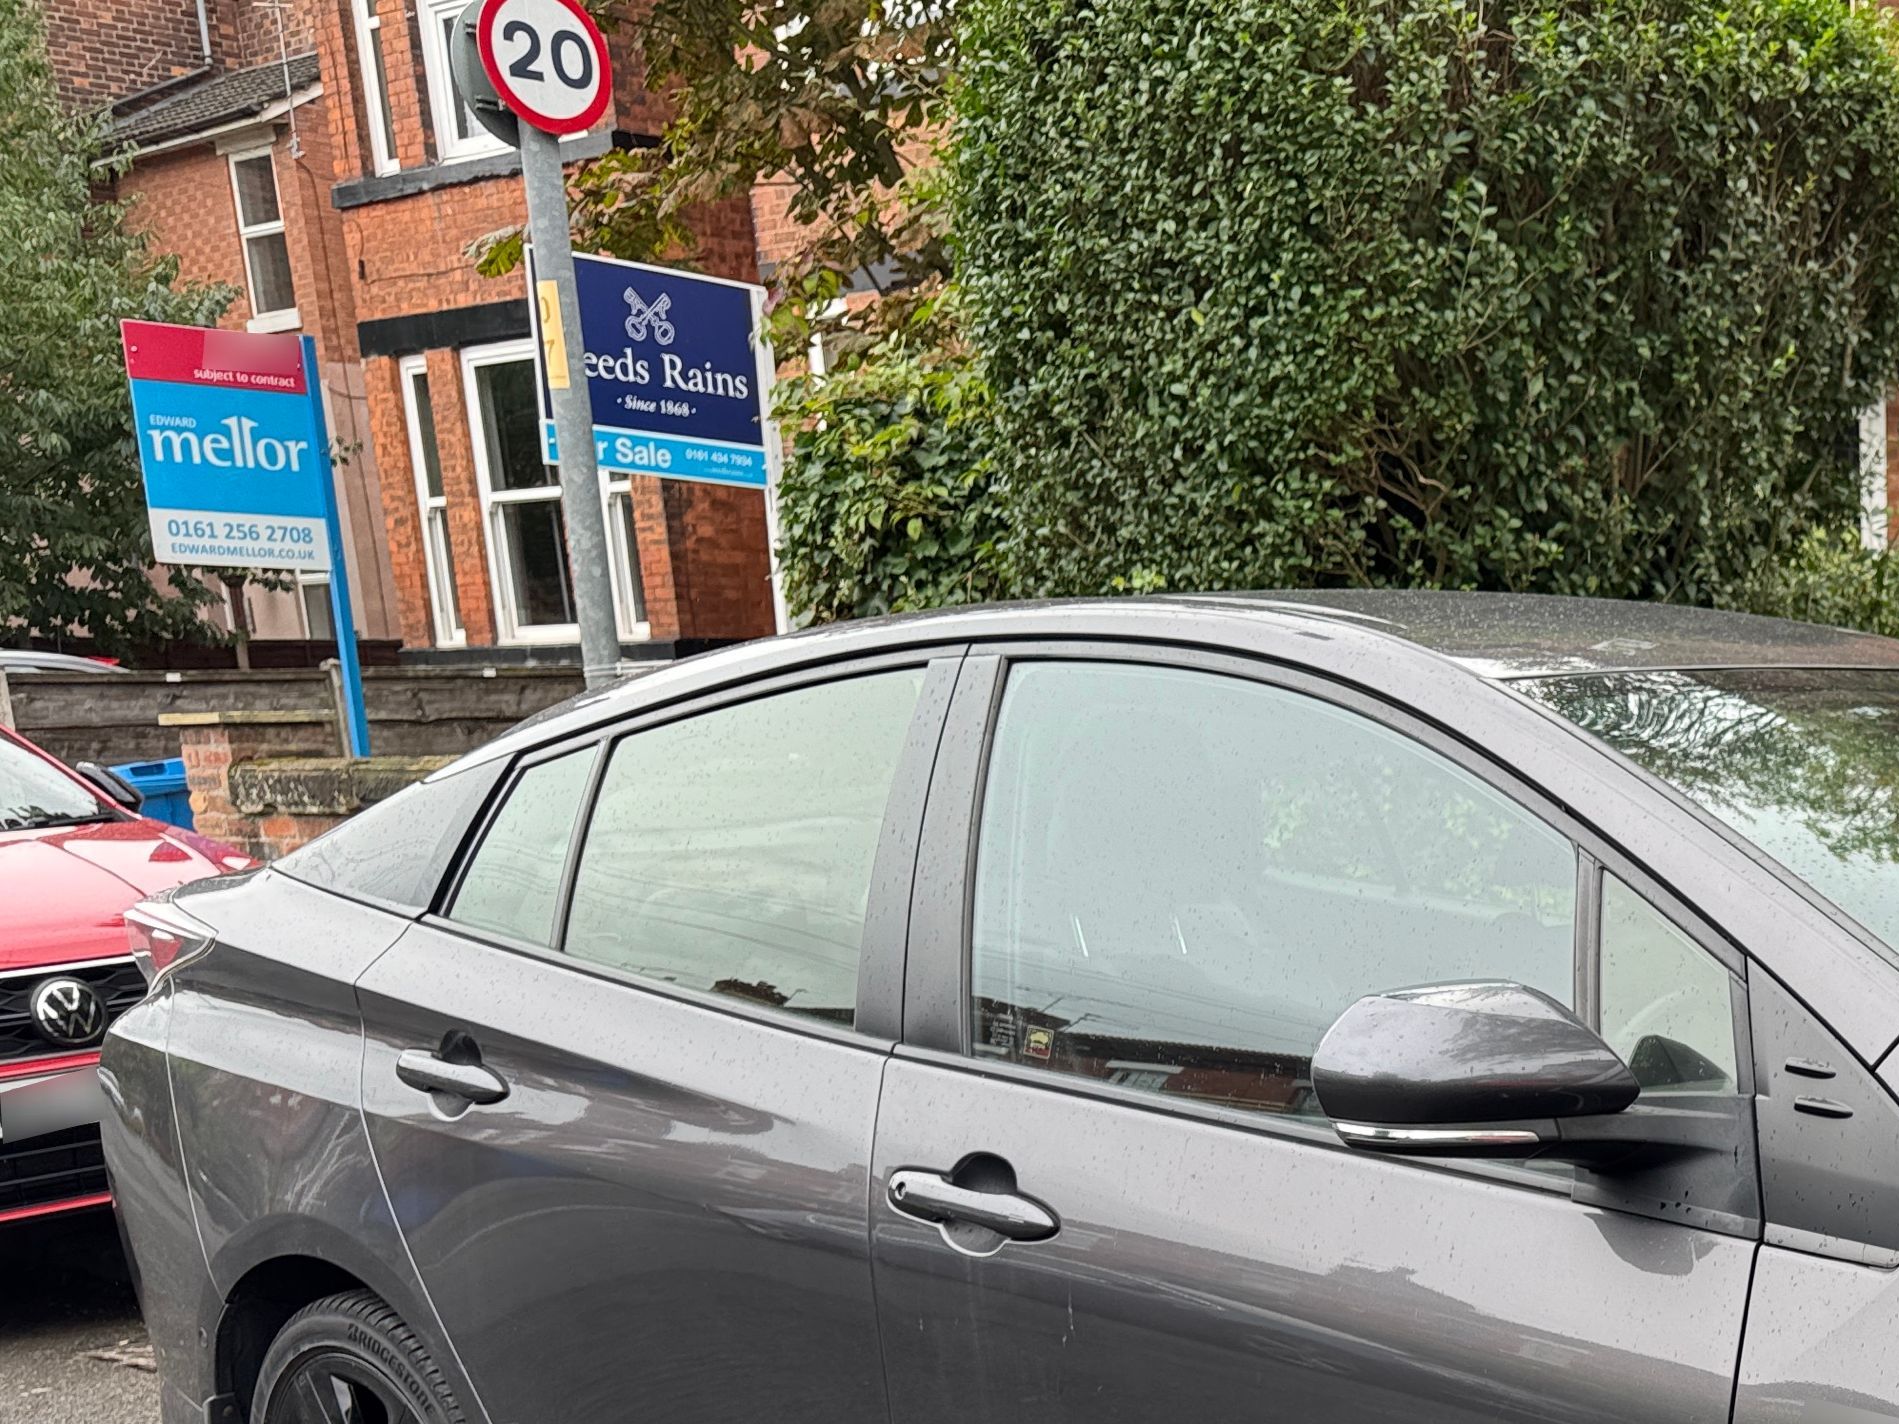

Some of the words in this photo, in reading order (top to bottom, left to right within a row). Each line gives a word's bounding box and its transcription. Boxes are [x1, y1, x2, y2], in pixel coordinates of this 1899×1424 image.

[503, 20, 593, 90] 20
[193, 368, 234, 383] subject
[236, 371, 249, 384] to
[250, 374, 296, 388] contract
[583, 347, 650, 385] eeds
[660, 352, 749, 399] Rains
[624, 394, 657, 413] Since
[660, 400, 690, 417] 1868
[149, 414, 197, 429] EDWARD
[147, 415, 308, 472] mellor
[615, 436, 672, 468] Sale
[167, 519, 218, 540] 0161
[223, 522, 260, 542] 256
[264, 525, 313, 544] 2708
[171, 542, 315, 561] EDWARDMELLOR.CO.UK
[346, 1322, 436, 1416] BRIDGESTONE
